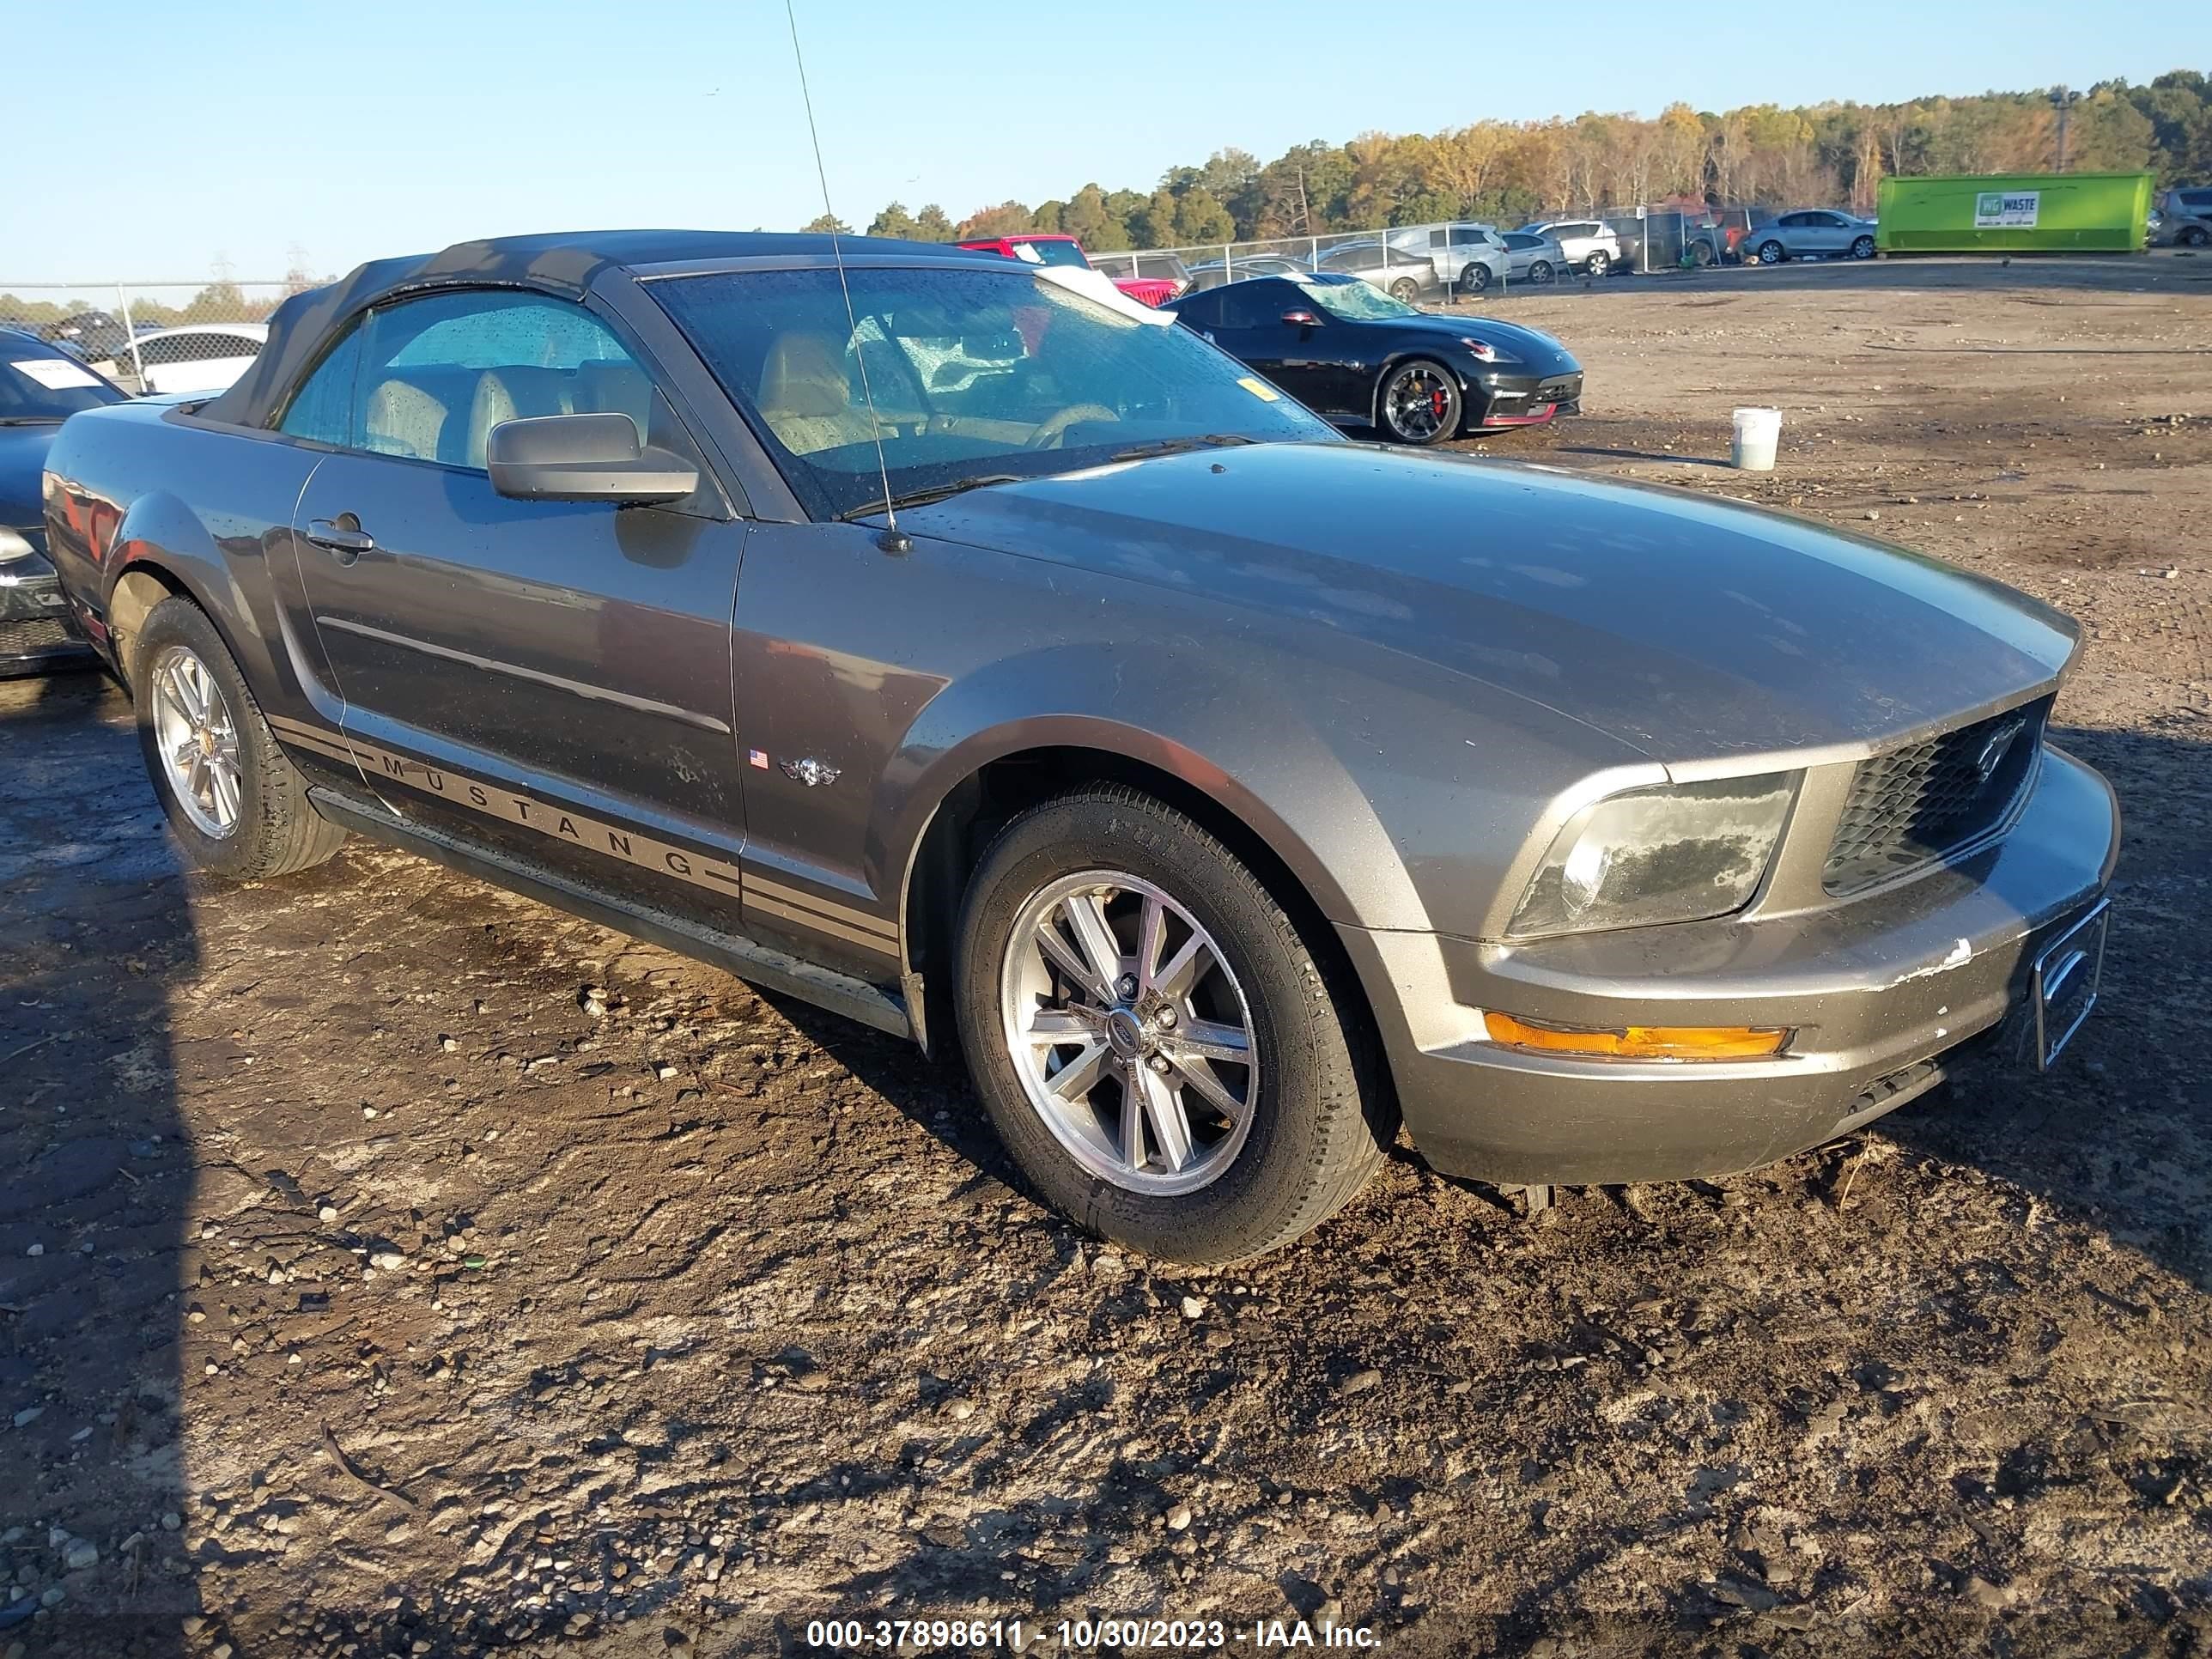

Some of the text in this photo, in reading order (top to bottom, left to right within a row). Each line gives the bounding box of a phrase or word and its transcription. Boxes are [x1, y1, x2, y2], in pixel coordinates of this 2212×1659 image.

[2003, 198, 2035, 211] WASTE
[382, 756, 691, 876] MUSTANG
[1115, 1022, 1133, 1045] Ford
